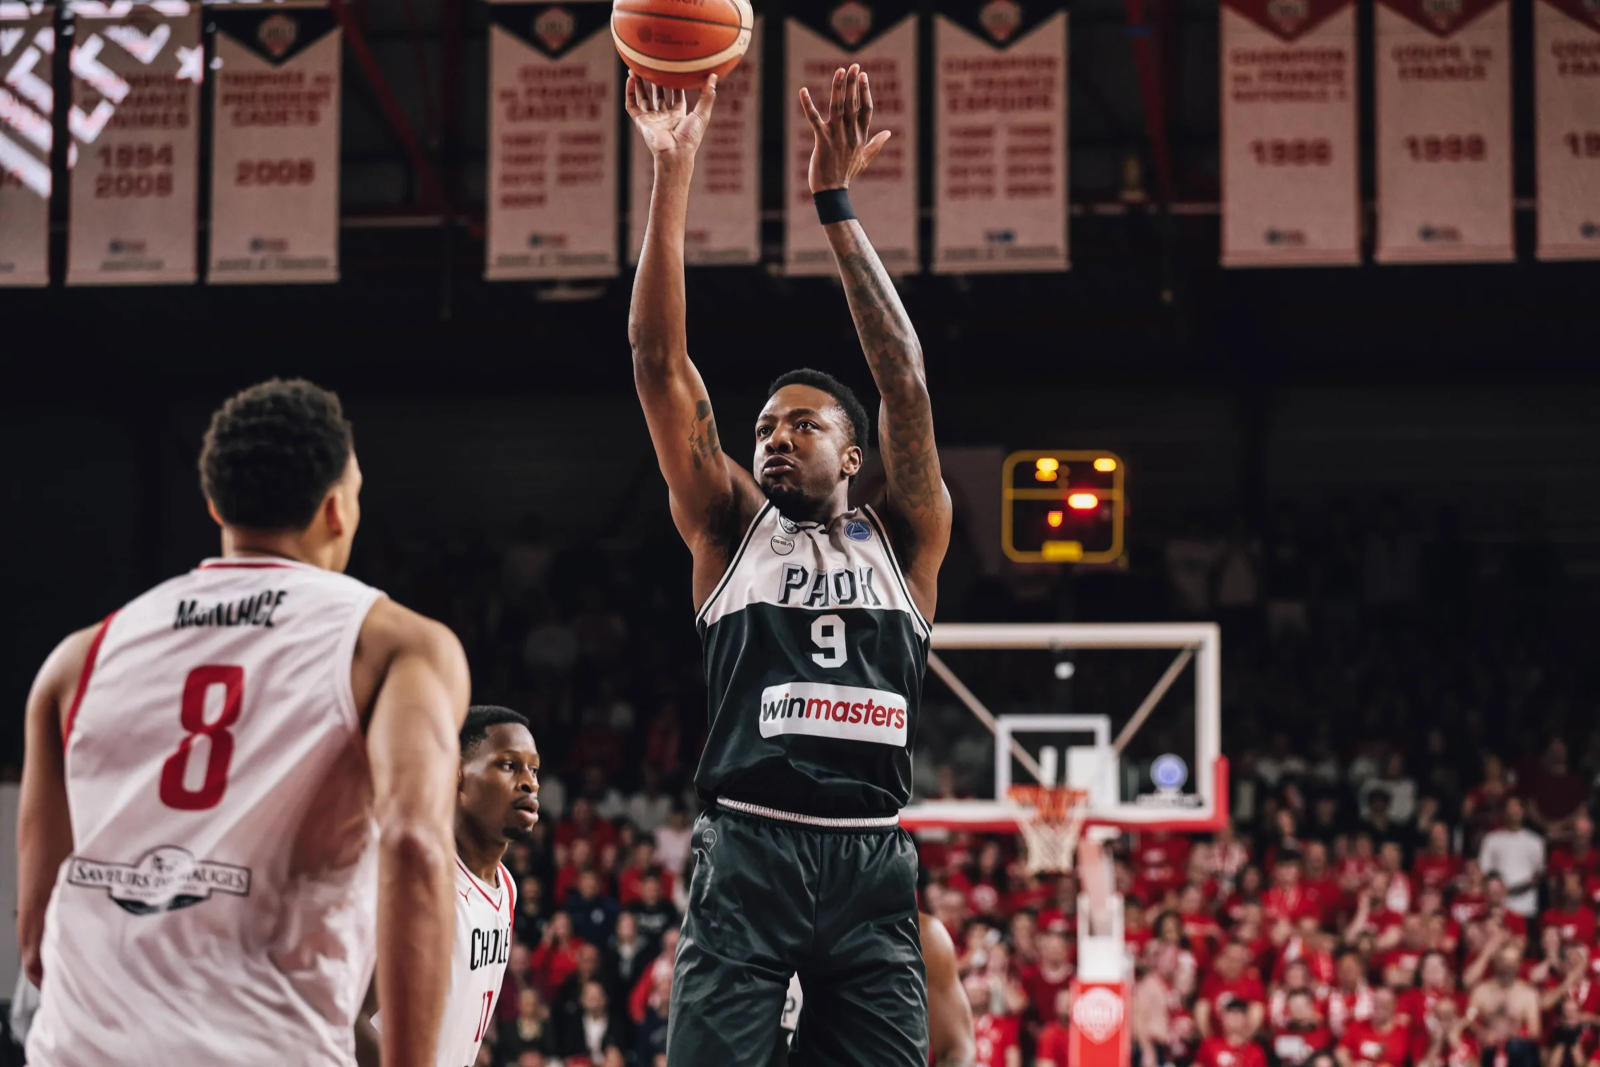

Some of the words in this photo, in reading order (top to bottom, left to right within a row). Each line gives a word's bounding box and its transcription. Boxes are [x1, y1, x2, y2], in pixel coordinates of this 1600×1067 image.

[778, 563, 881, 607] PAOK
[811, 614, 848, 668] 9
[763, 693, 905, 730] winmasters
[159, 664, 244, 812] 8
